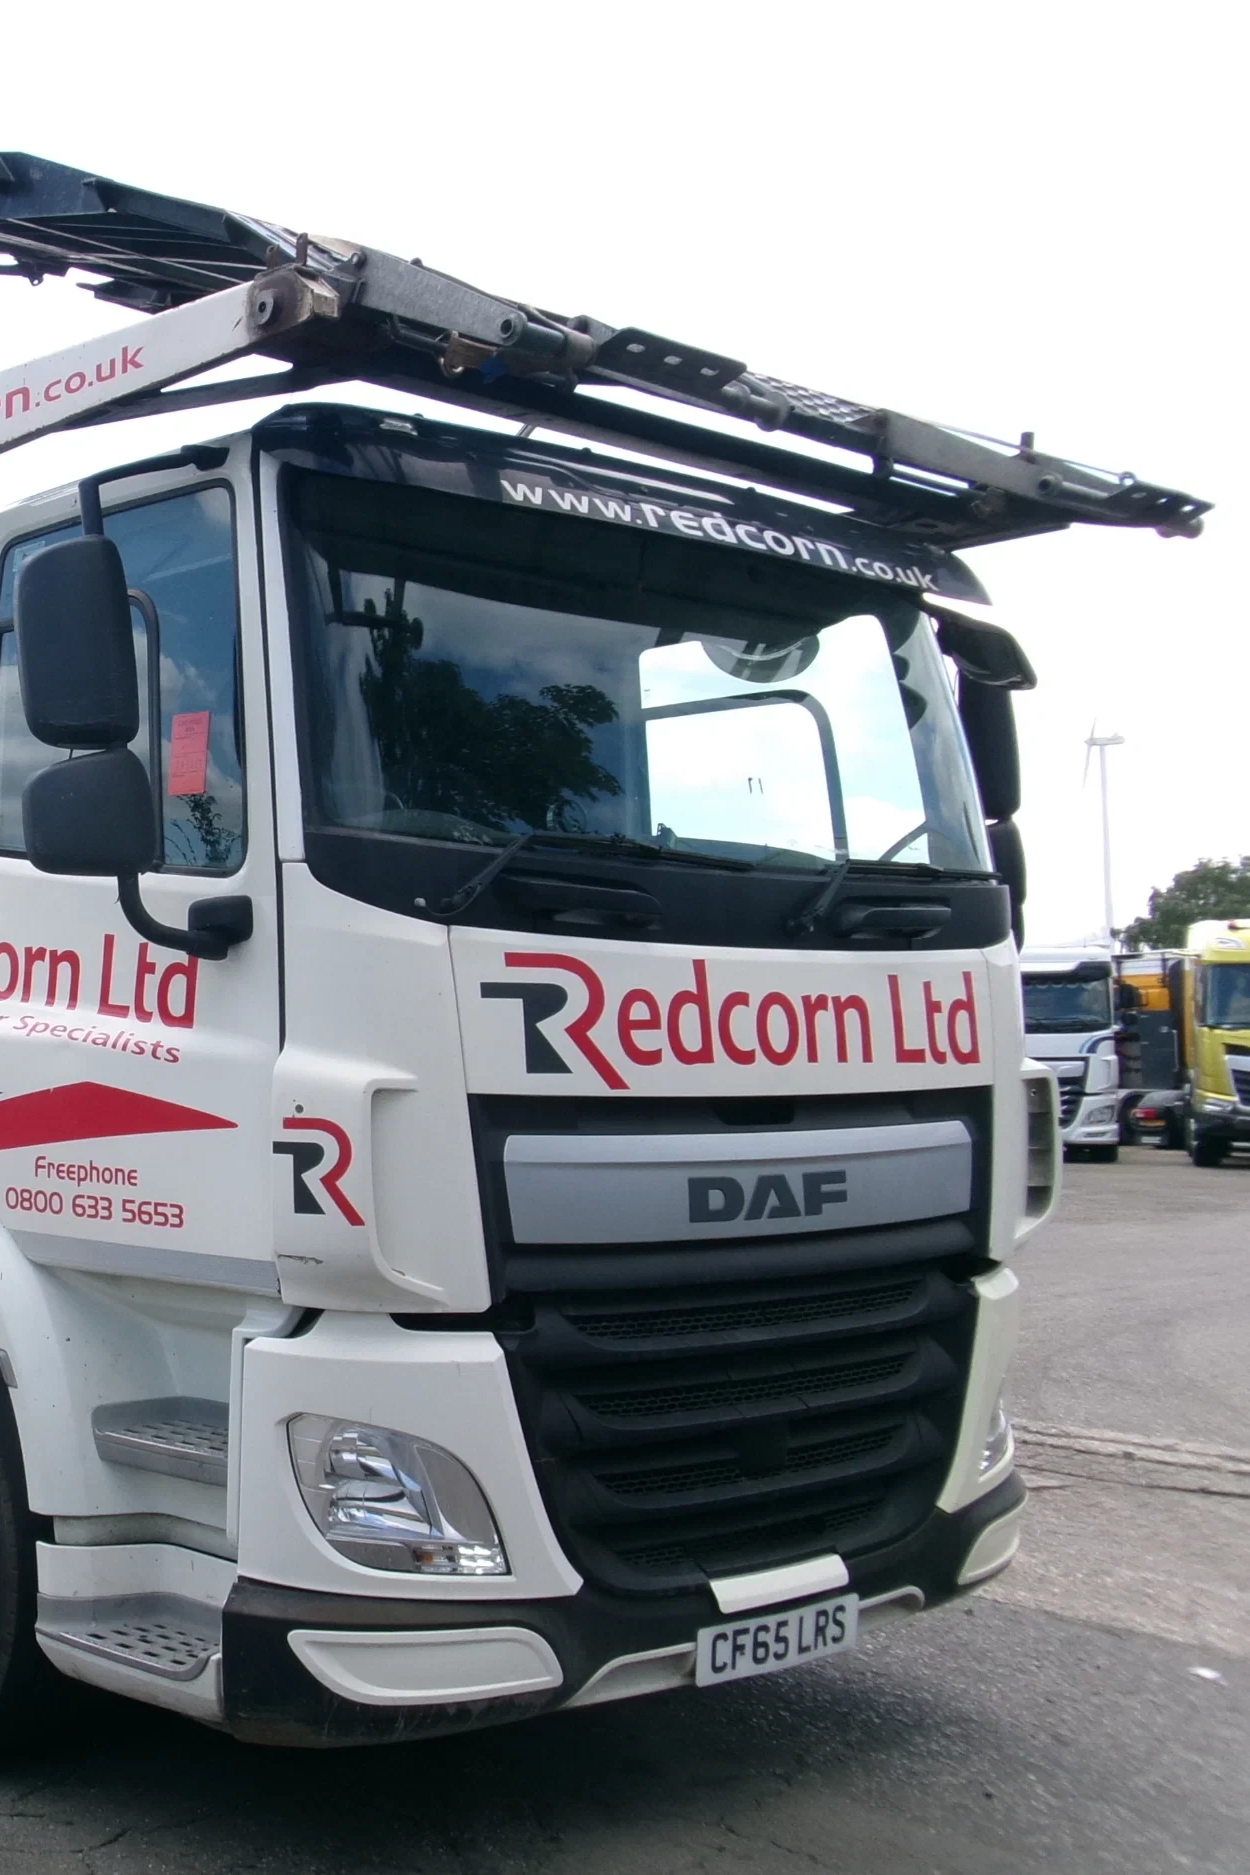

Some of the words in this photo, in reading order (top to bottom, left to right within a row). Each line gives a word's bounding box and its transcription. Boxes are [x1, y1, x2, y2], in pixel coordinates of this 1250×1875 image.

[500, 479, 939, 592] www.redcorn.co.uk
[97, 933, 199, 1029] Ltd
[12, 1015, 181, 1063] Specialists
[479, 951, 874, 1090] Redcorn
[886, 970, 981, 1065] Ltd
[34, 1156, 138, 1187] Freephone
[687, 1170, 848, 1223] DAF
[5, 1187, 64, 1215] 0800
[72, 1194, 113, 1221] 633
[121, 1199, 184, 1229] 5653
[711, 1620, 790, 1675] CF65
[797, 1604, 847, 1655] LRS
